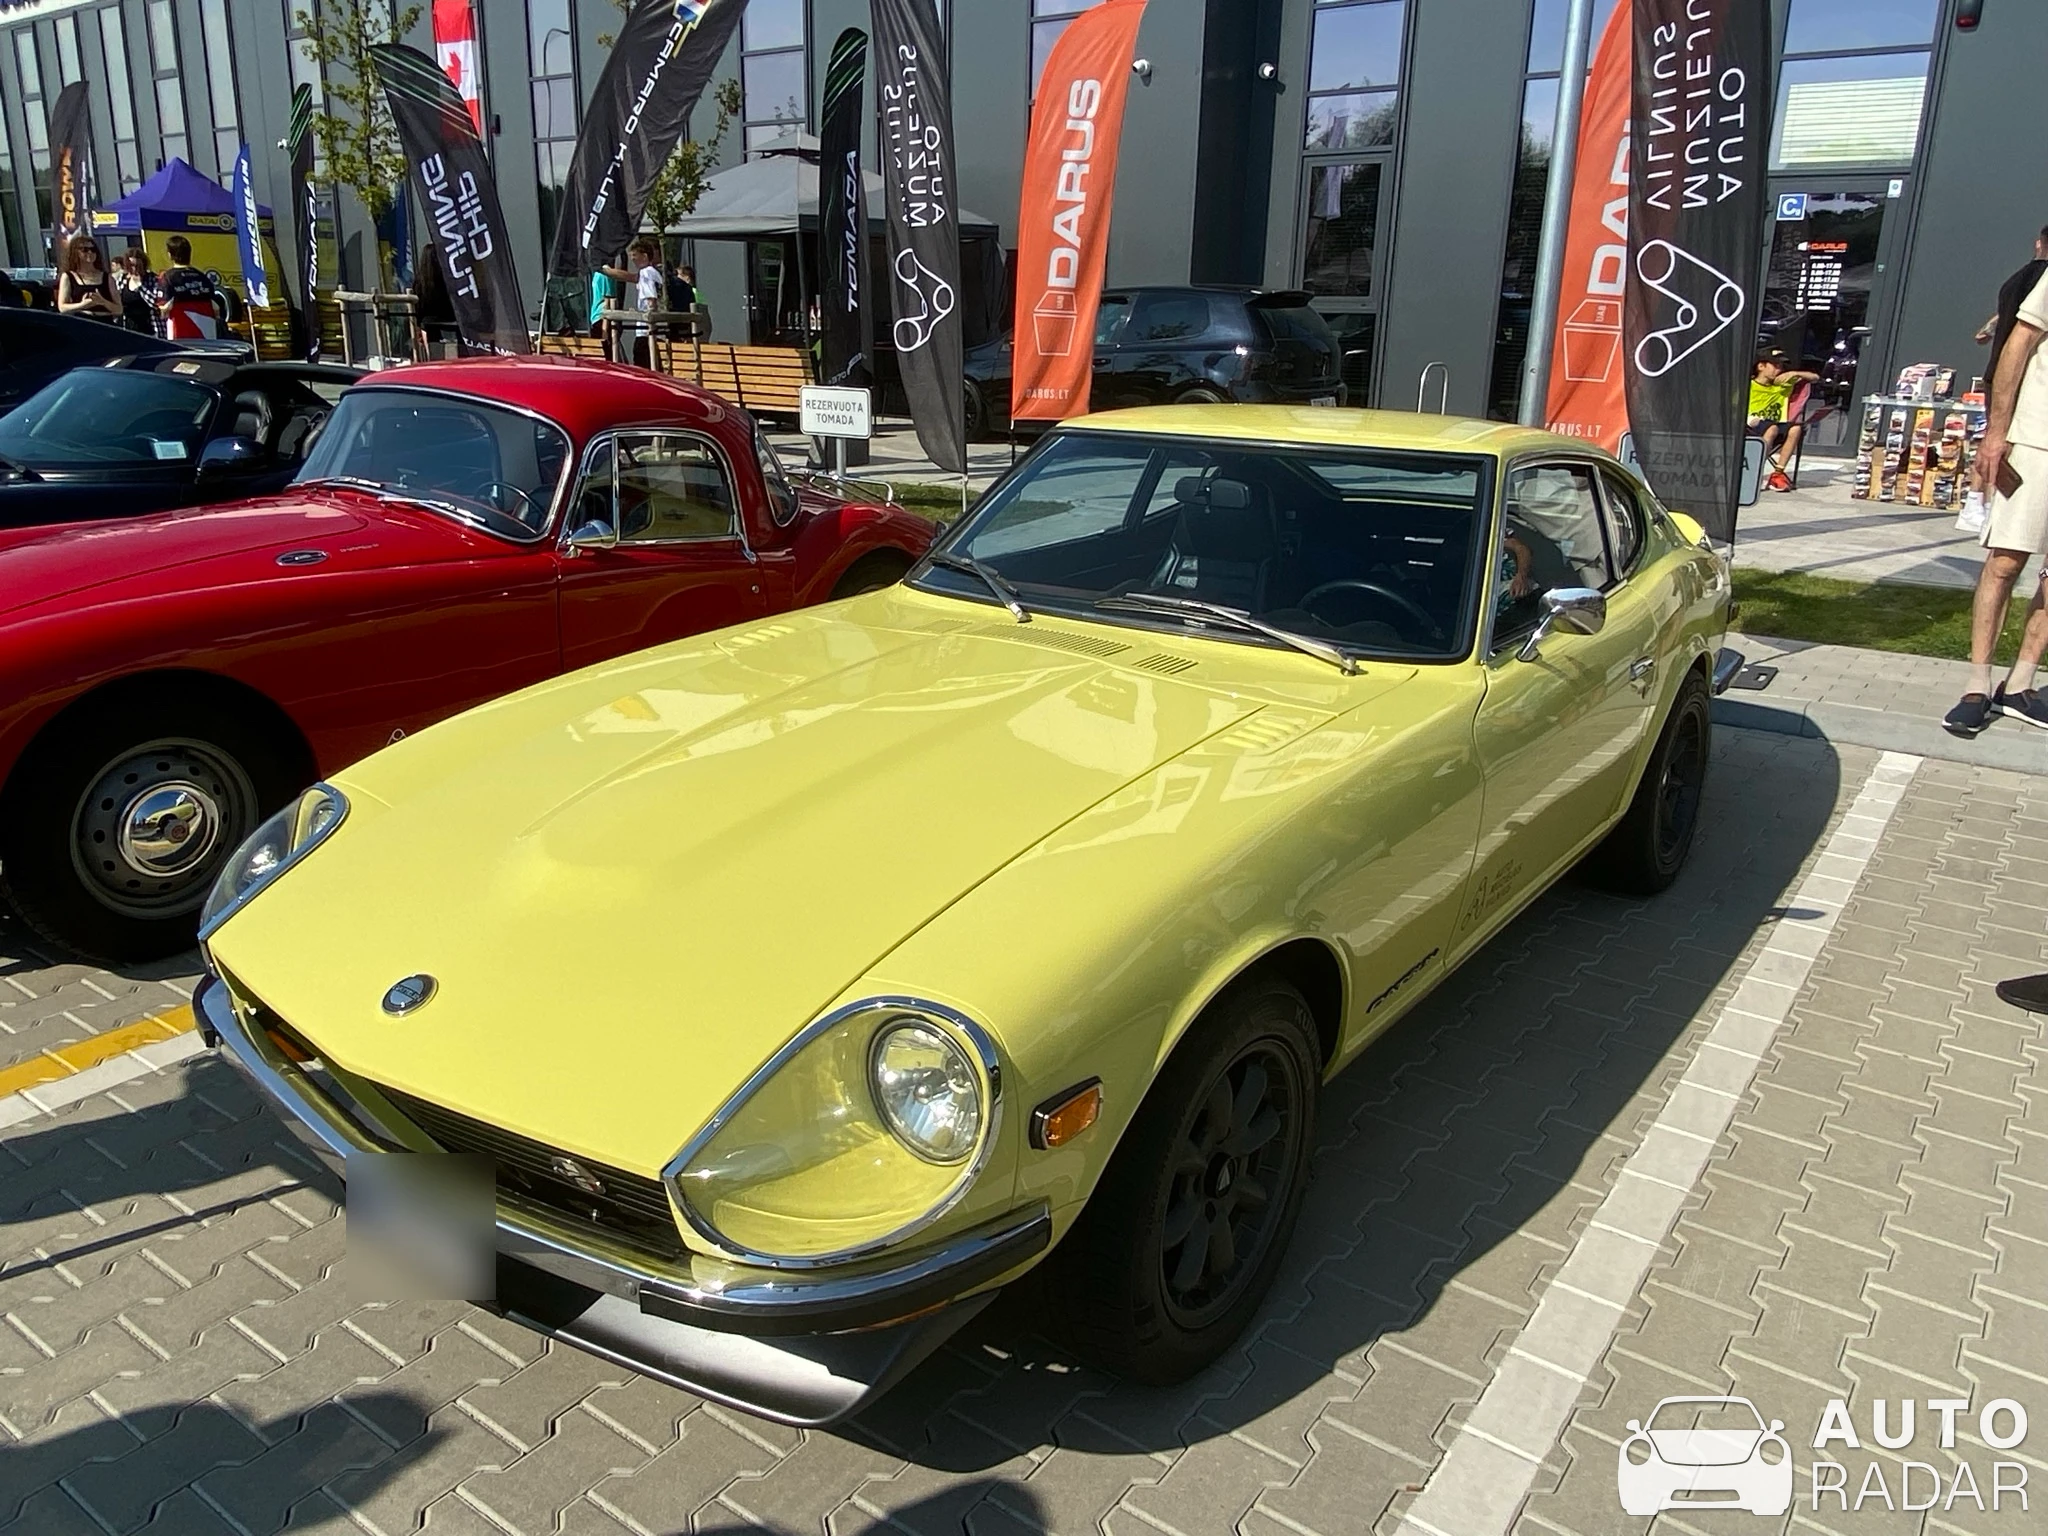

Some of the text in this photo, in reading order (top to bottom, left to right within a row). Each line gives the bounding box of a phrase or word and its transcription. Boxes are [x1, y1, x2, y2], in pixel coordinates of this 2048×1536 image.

[625, 22, 684, 135] CAMARO
[241, 158, 261, 268] MICHELIN
[846, 150, 858, 313] TOMADA
[1047, 78, 1101, 290] DARUS
[1586, 118, 1632, 297] DAR
[1596, 305, 1607, 322] UAB
[805, 399, 864, 412] REZERVUOTA
[816, 413, 854, 425] TOMADA
